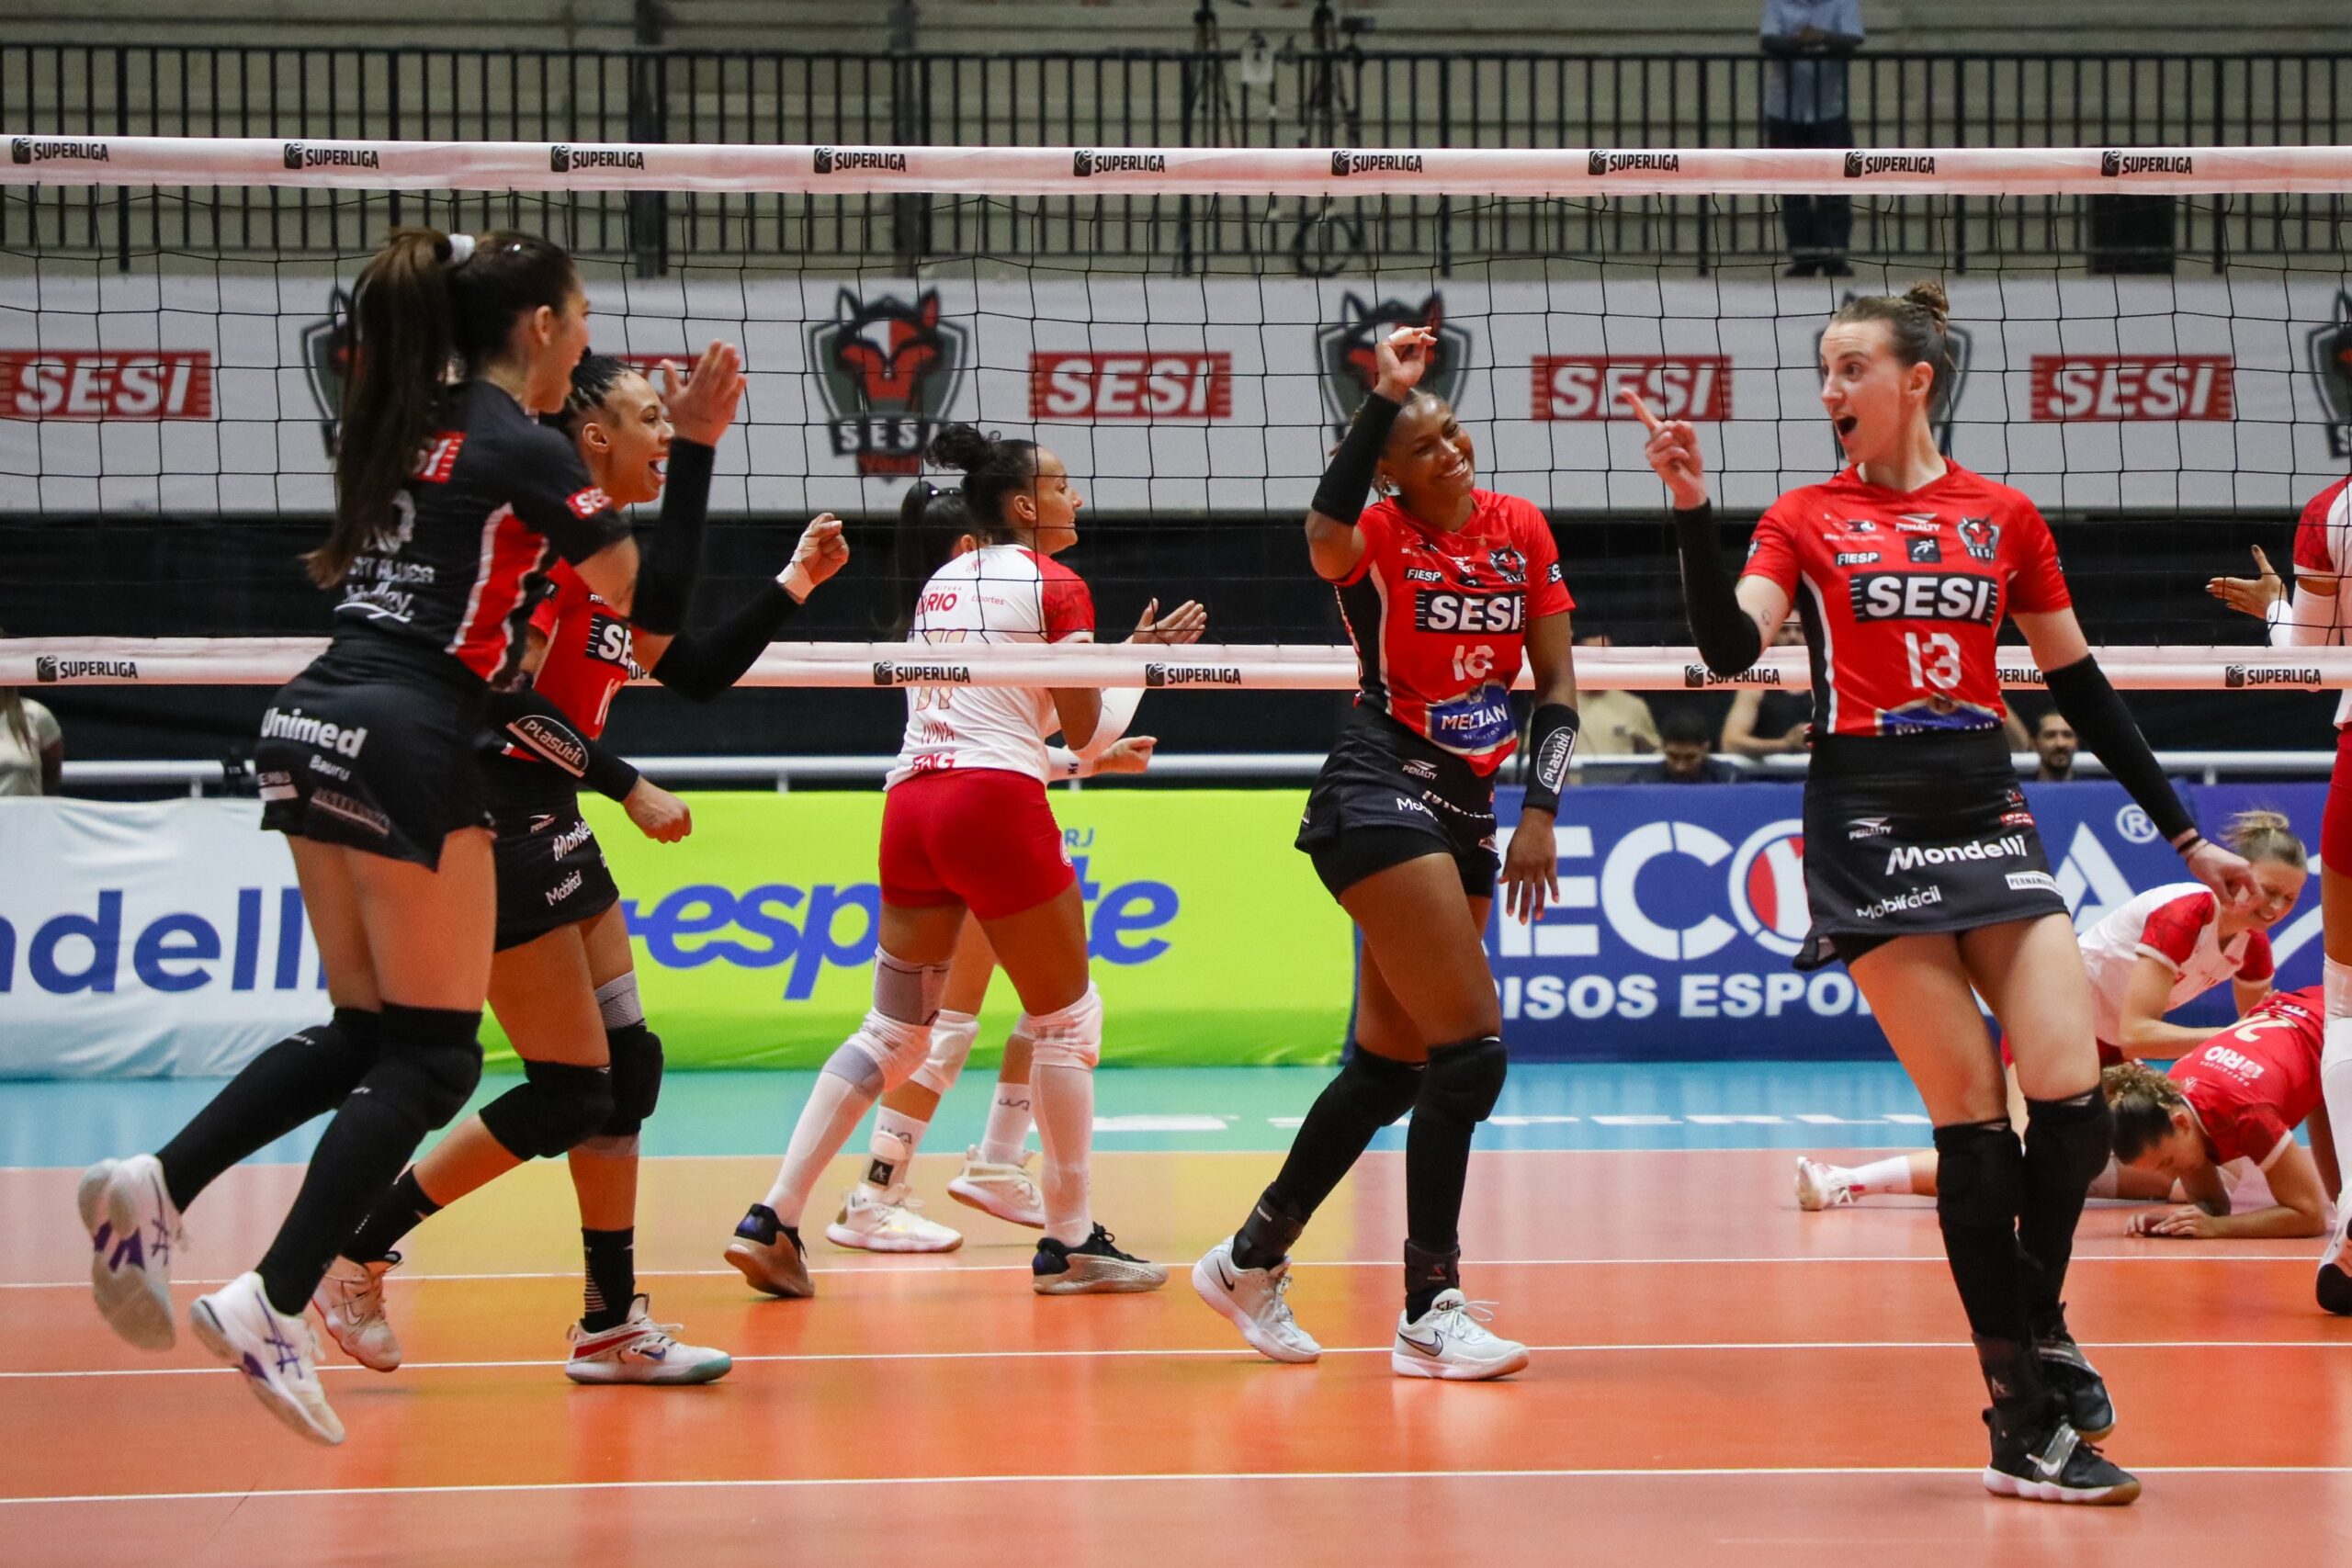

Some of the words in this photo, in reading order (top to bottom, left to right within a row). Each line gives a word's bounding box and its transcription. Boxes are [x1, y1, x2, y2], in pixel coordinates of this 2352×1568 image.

[34, 142, 109, 163] SUPERLIGA
[305, 148, 379, 169] SUPERLIGA
[571, 151, 644, 171] SUPERLIGA
[834, 152, 906, 172] SUPERLIGA
[1094, 154, 1165, 174] SUPERLIGA
[1352, 155, 1422, 174] SUPERLIGA
[1609, 154, 1679, 173] SUPERLIGA
[1865, 156, 1935, 175] SUPERLIGA
[2121, 156, 2192, 175] SUPERLIGA
[16, 362, 191, 415] SESI
[1046, 359, 1211, 415] SESI
[1550, 362, 1717, 417] SESI
[2047, 362, 2216, 416] SESI
[1838, 552, 1879, 566] FIESP
[1407, 569, 1441, 581] FIESP
[1866, 576, 1989, 620] SESI
[1428, 595, 1521, 632] SESI
[60, 661, 139, 679] SUPERLIGA
[1452, 645, 1495, 682] 16
[1905, 632, 1962, 689] 13
[896, 666, 970, 683] SUPERLIGA
[1168, 668, 1241, 684] SUPERLIGA
[2247, 669, 2322, 686] SUPERLIGA
[260, 706, 368, 759] Unimed
[309, 753, 351, 783] Bauru
[1402, 764, 1438, 780] PENALTY
[1885, 835, 2028, 875] Mondelli
[1492, 974, 1658, 1019] ISOS
